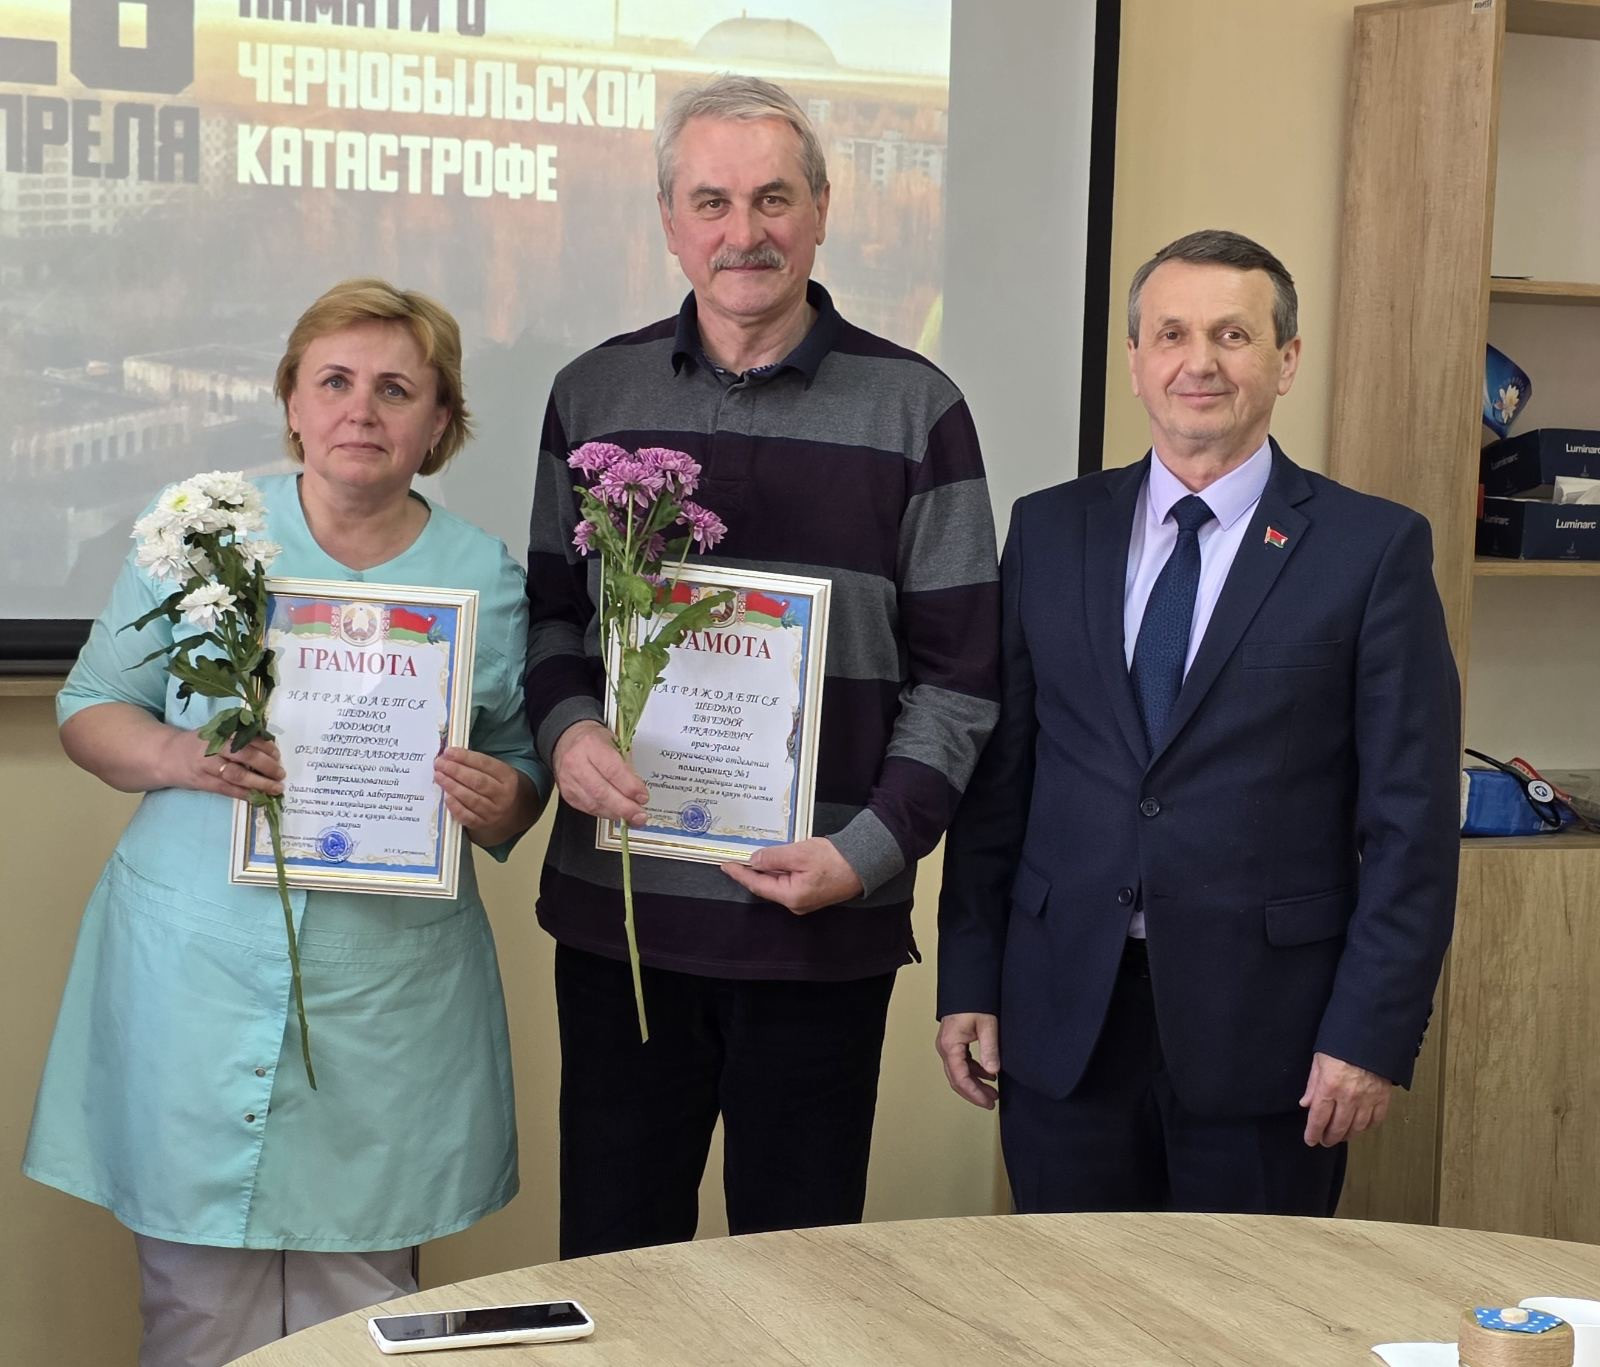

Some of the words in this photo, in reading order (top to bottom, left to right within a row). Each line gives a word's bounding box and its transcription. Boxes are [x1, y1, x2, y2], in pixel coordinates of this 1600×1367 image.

[238, 41, 656, 130] ЧЕРНОБЫЛЬСКОЙ
[237, 124, 558, 202] КАТАСТРОФЕ
[1556, 518, 1597, 530] Luminarc
[675, 629, 772, 659] АМОТА
[298, 646, 418, 677] ГРАМОТА
[287, 690, 428, 710] НАГРАЖДАЕТСЯ
[329, 721, 391, 733] ЛЮДМИЛА
[692, 713, 744, 727] ЕВГЕНИЙ
[680, 725, 753, 741] АРКАДЬЕВИЧ
[690, 740, 740, 752] врач-уролог
[378, 763, 410, 774] отдела
[725, 756, 770, 768] отделения
[678, 763, 732, 777] поликлиники
[734, 769, 750, 778] №1
[316, 773, 400, 787] централизованной
[289, 784, 364, 799] диагностической
[366, 789, 425, 803] лаборатории
